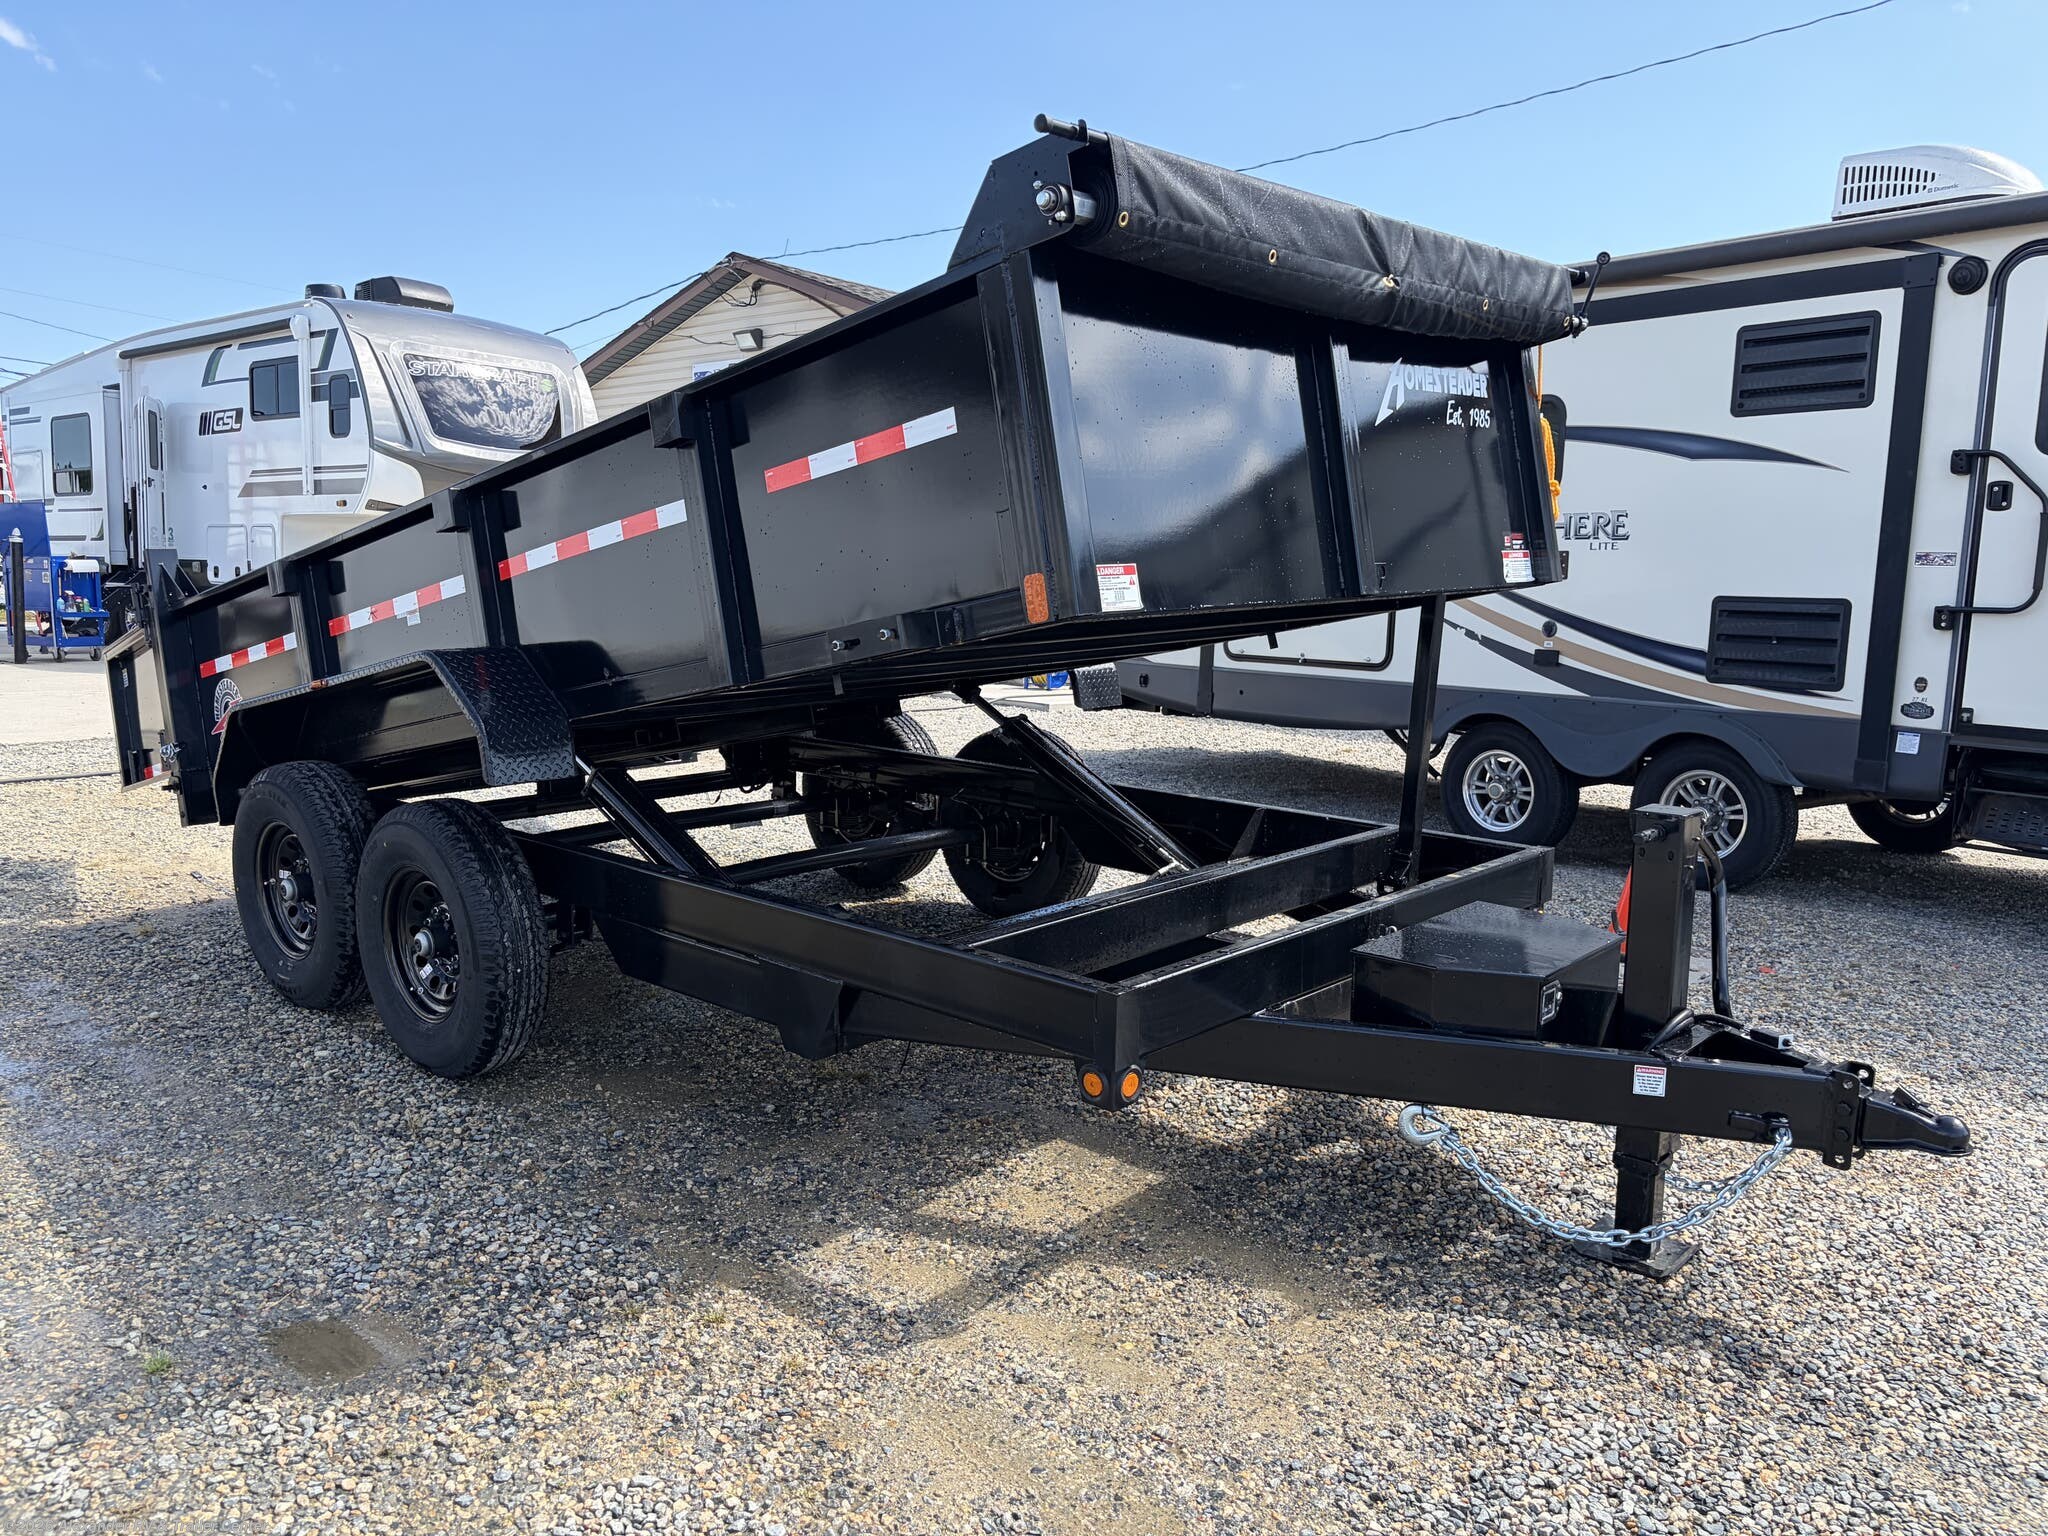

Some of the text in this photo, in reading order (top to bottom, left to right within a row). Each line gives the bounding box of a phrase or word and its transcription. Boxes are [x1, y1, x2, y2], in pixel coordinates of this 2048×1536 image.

[1375, 357, 1489, 427] HOMESTEADER
[213, 410, 241, 431] GSL
[1469, 408, 1491, 428] 1985
[1589, 542, 1620, 551] LITE
[1100, 566, 1125, 575] DANGER
